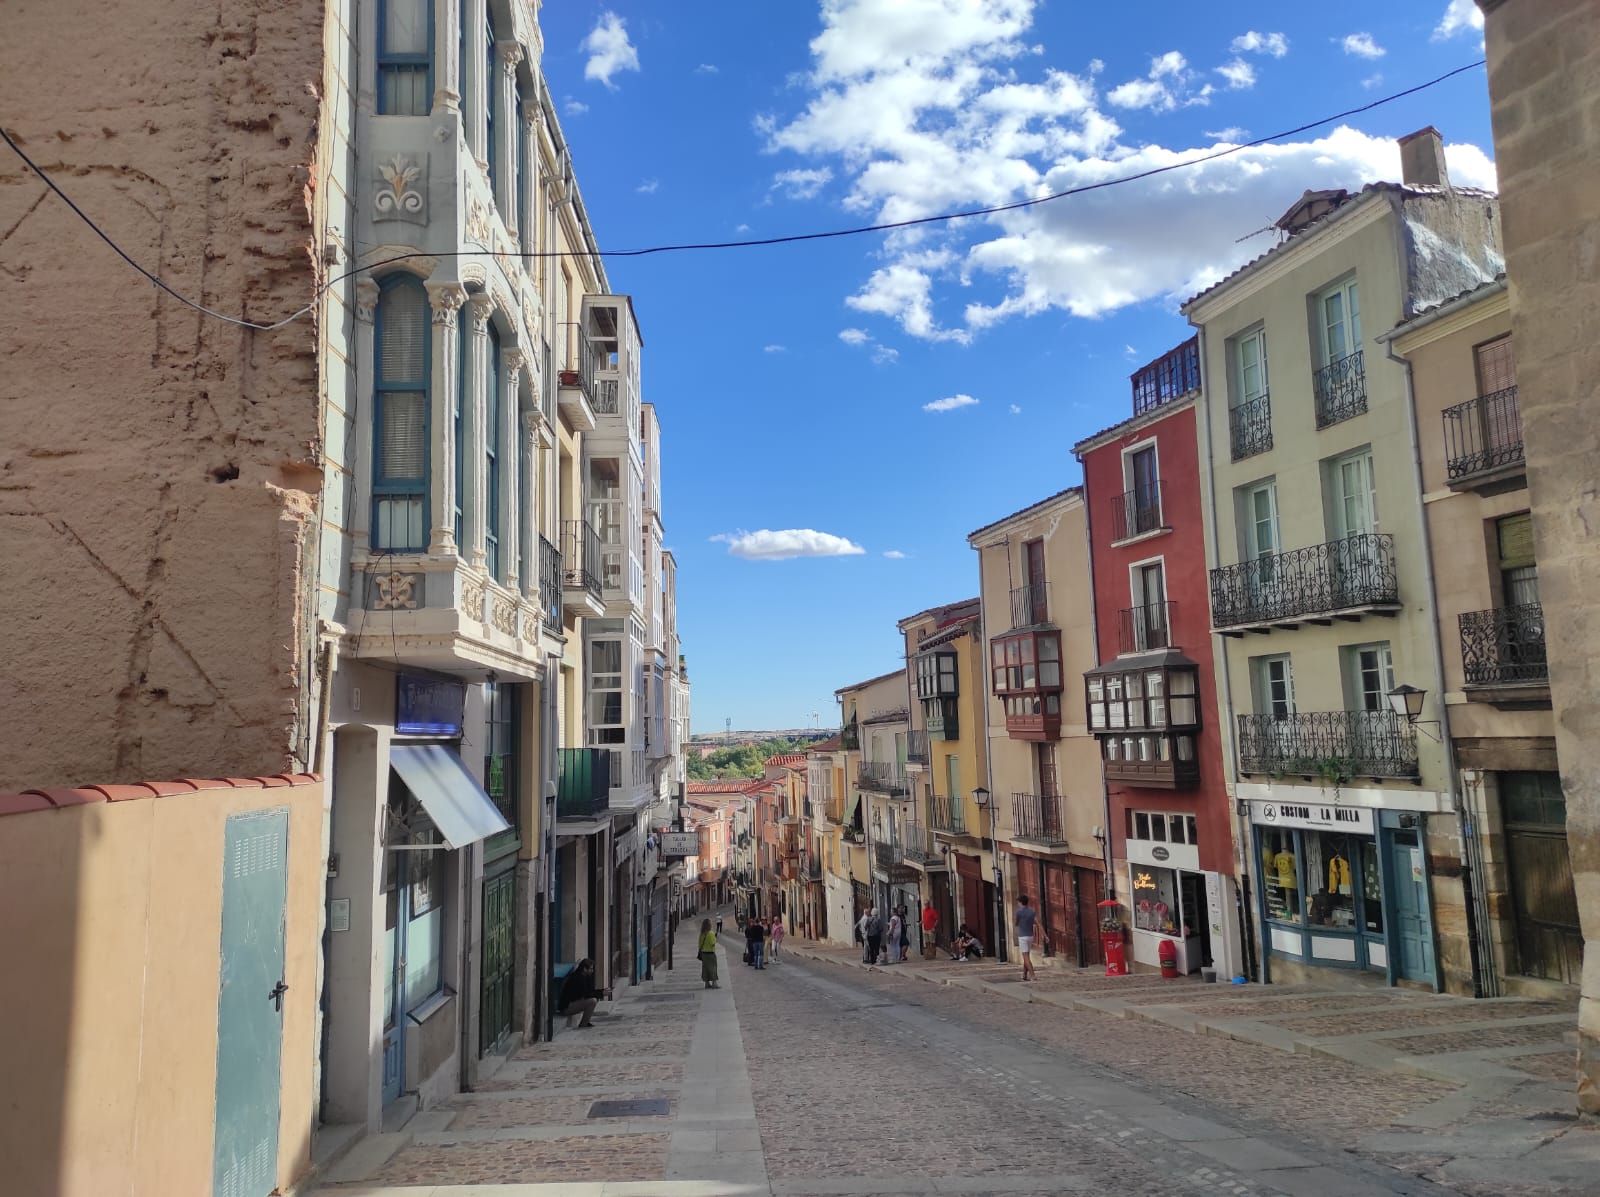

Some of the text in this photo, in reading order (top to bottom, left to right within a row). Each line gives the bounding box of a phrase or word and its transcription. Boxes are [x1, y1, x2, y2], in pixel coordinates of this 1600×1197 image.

[1280, 805, 1310, 819] CUSTOM
[1320, 808, 1331, 821] LA
[1335, 807, 1360, 823] MILLA
